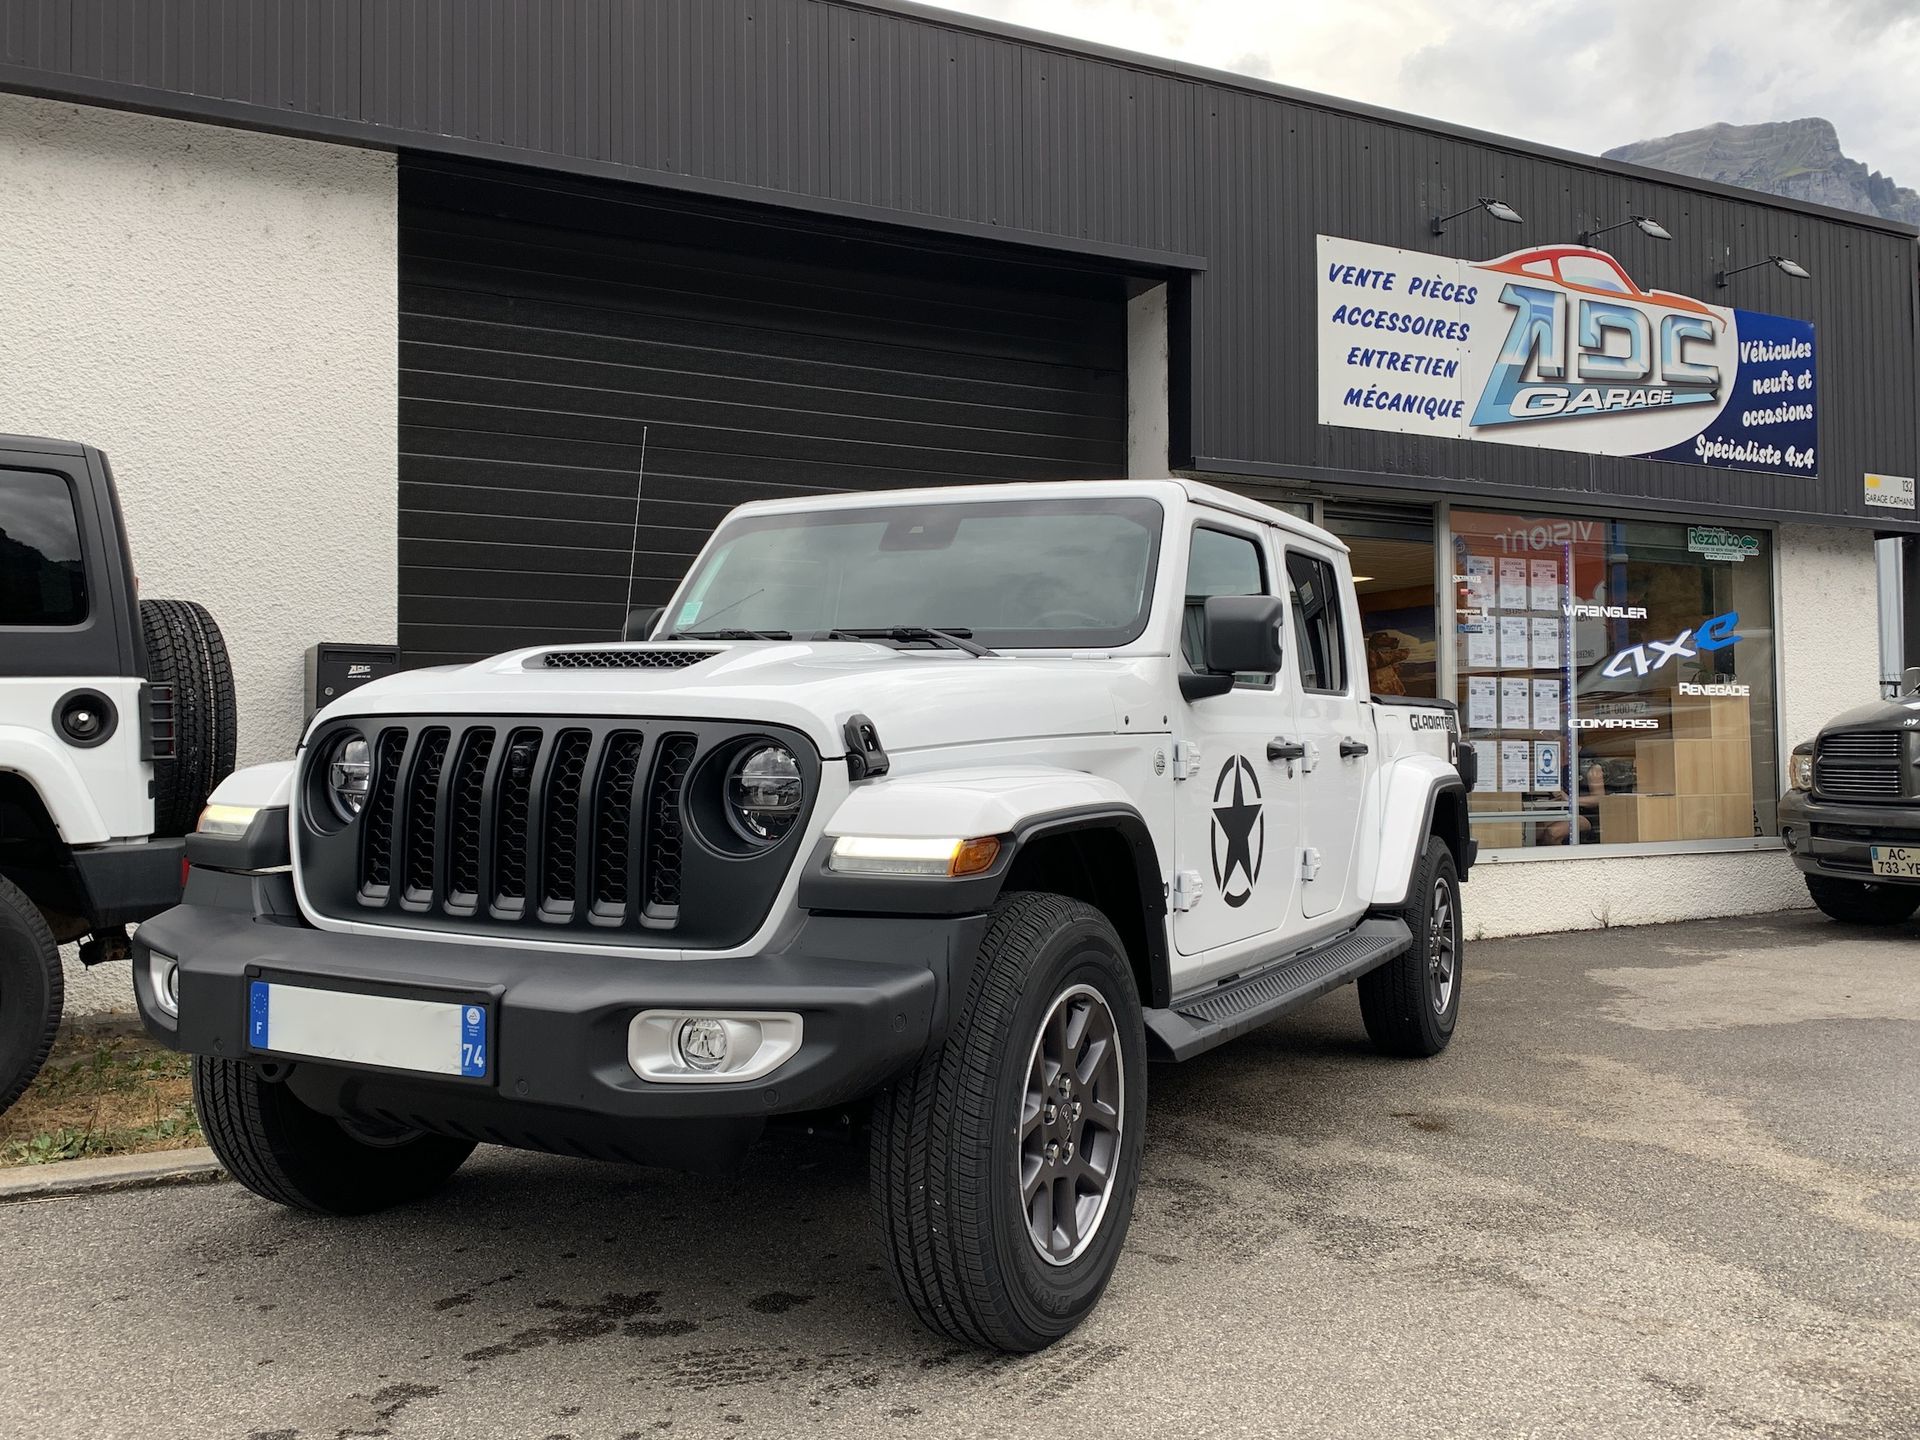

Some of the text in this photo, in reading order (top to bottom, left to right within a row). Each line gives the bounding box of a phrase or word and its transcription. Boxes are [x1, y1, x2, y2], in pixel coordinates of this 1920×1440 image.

[1329, 263, 1478, 305] VENTE PIÈCES
[1332, 304, 1471, 342] ACCESSOIRES
[1480, 283, 1719, 400] ADC
[1740, 337, 1812, 364] Véhicules
[1347, 347, 1459, 378] ENTRETIEN
[1752, 369, 1813, 395] neufs et
[1343, 383, 1465, 421] MÉCANIQUE
[1508, 387, 1674, 418] GARAGE
[1742, 401, 1813, 428] occasions
[1694, 433, 1815, 469] Spécialiste 4x4
[1865, 493, 1888, 504] GARAGE
[1902, 480, 1913, 493] 132
[1688, 528, 1740, 547] Rezauto
[1563, 604, 1648, 619] WRANGLER
[1678, 682, 1751, 697] RENEGADE
[1567, 718, 1659, 729] COMPASS
[256, 1021, 263, 1035] F
[462, 1043, 484, 1068] 74
